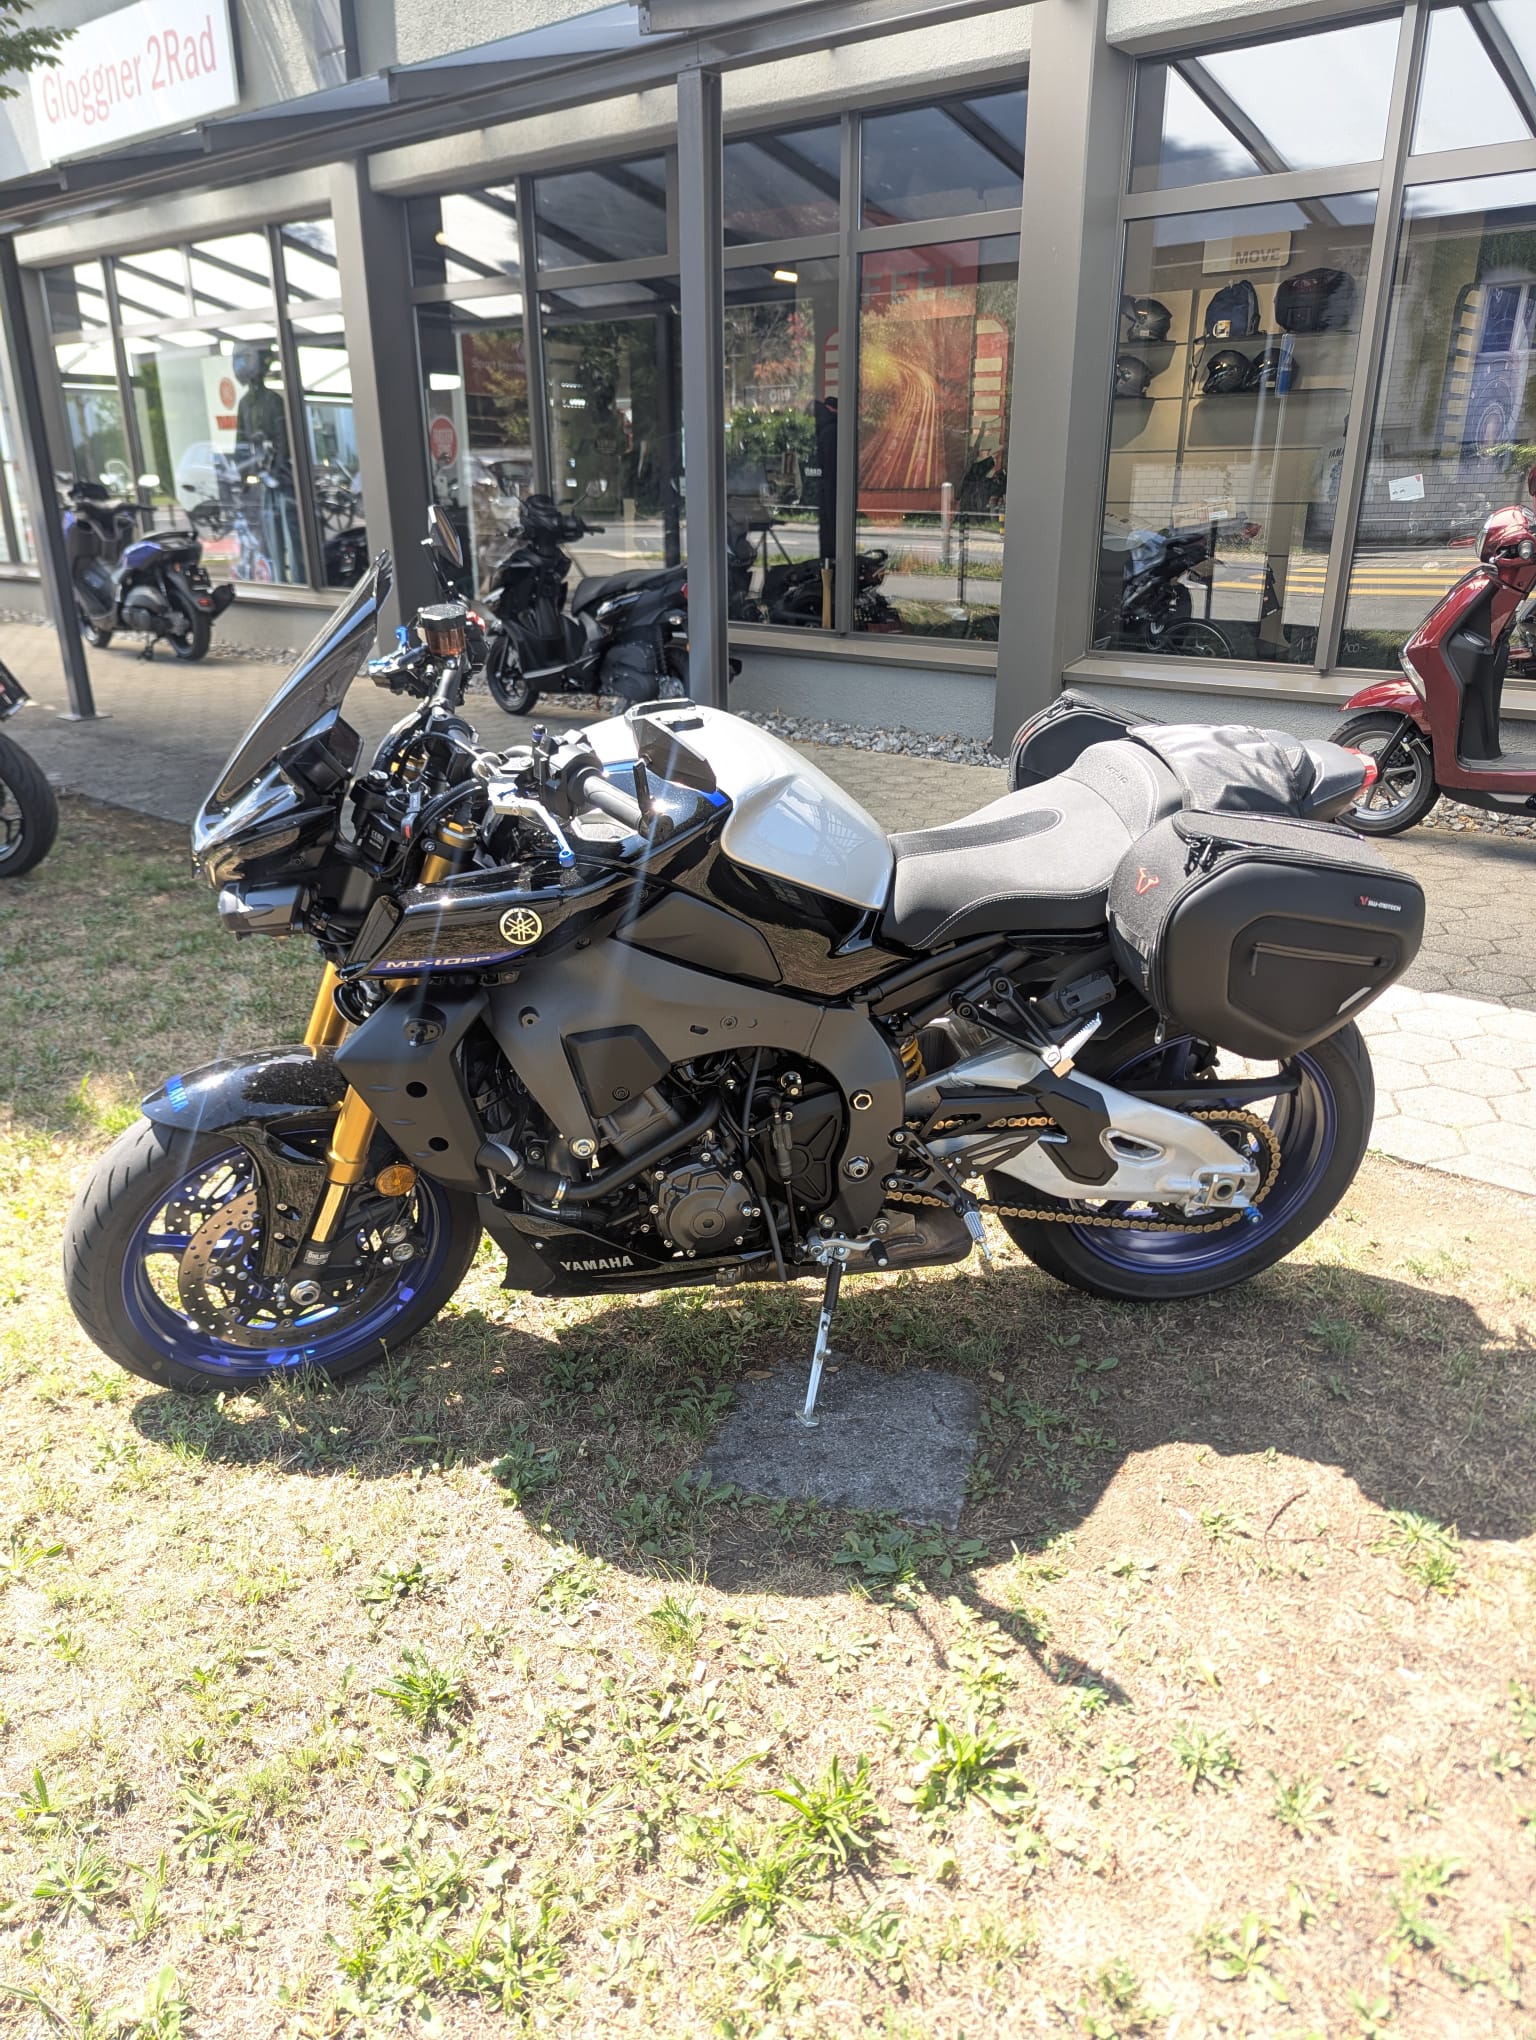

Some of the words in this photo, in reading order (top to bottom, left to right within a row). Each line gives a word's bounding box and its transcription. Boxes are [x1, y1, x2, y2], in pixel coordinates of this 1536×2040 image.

[42, 54, 141, 125] Gloggner
[147, 14, 217, 91] 2Rad
[1235, 247, 1281, 265] MOVE
[863, 264, 962, 307] FEEL
[559, 1255, 634, 1271] YAMAHA
